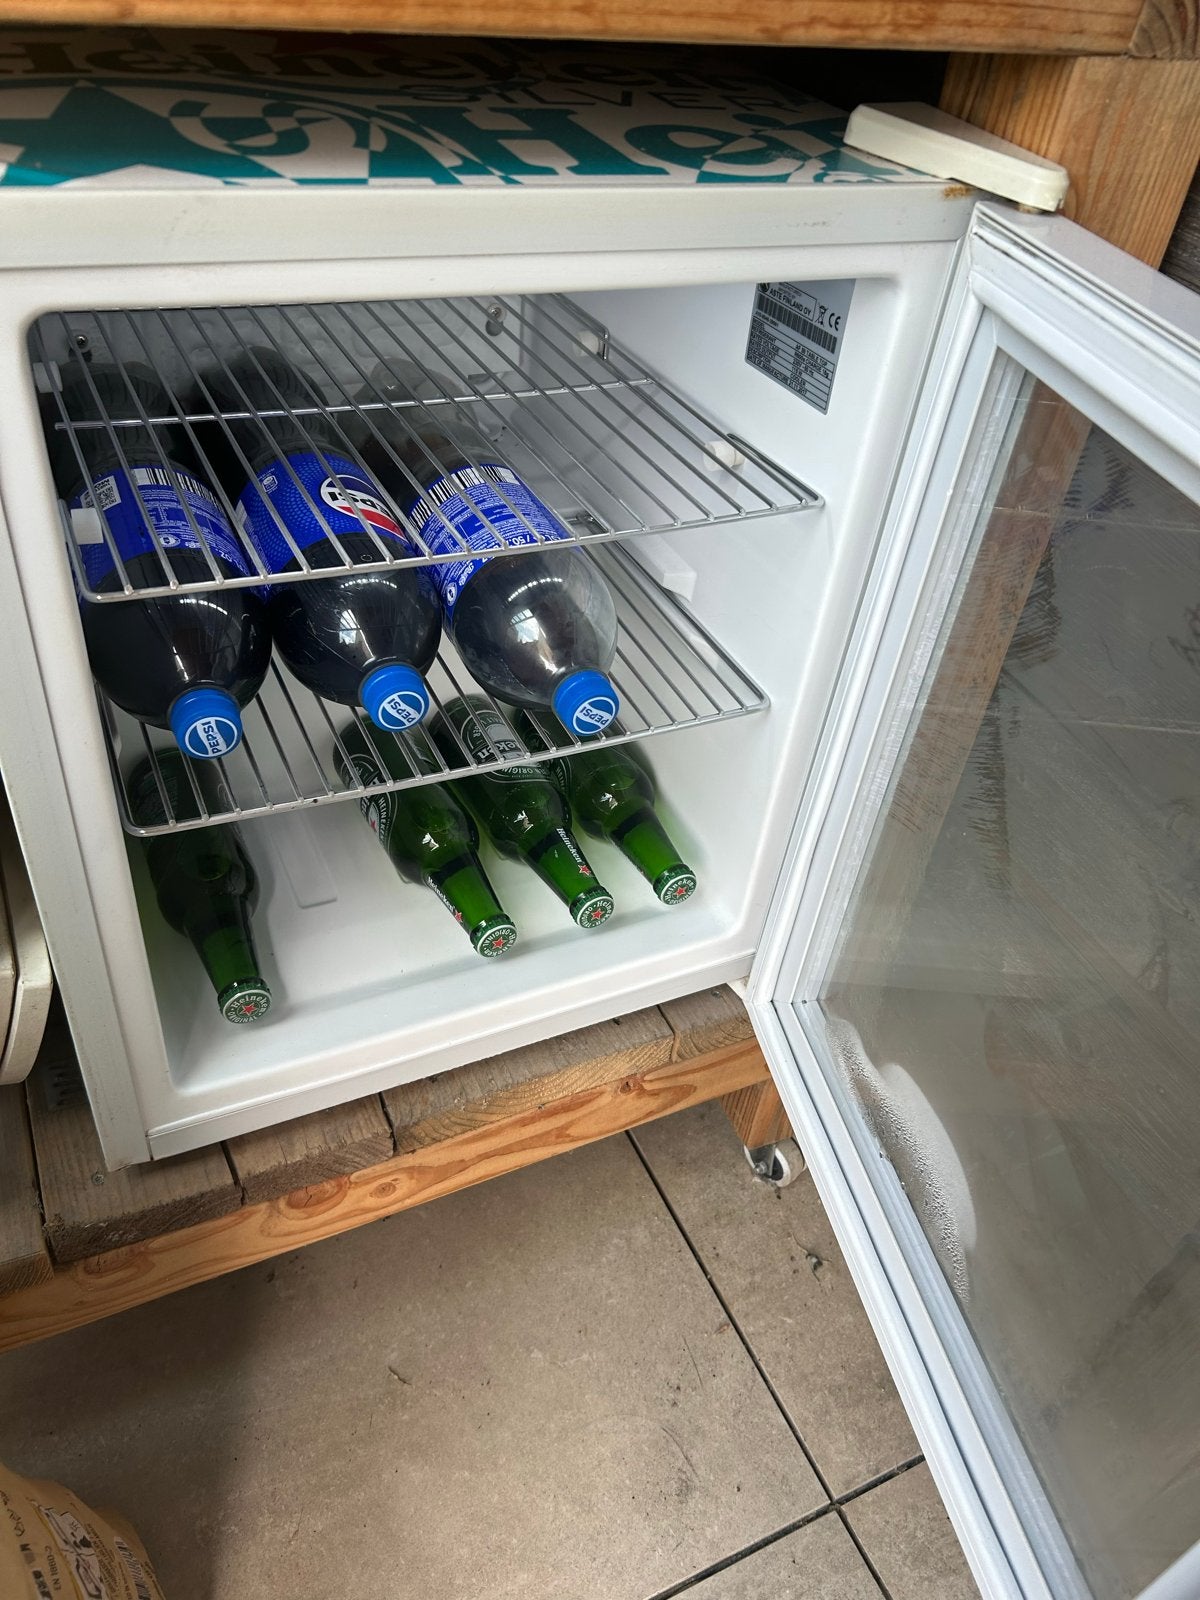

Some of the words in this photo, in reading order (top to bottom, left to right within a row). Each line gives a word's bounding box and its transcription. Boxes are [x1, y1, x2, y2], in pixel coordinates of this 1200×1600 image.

[387, 697, 417, 723] PEPSI
[578, 706, 609, 725] PEPSI
[200, 720, 222, 754] PEPSI
[556, 826, 583, 864] Heineken
[230, 995, 269, 1014] Heineken
